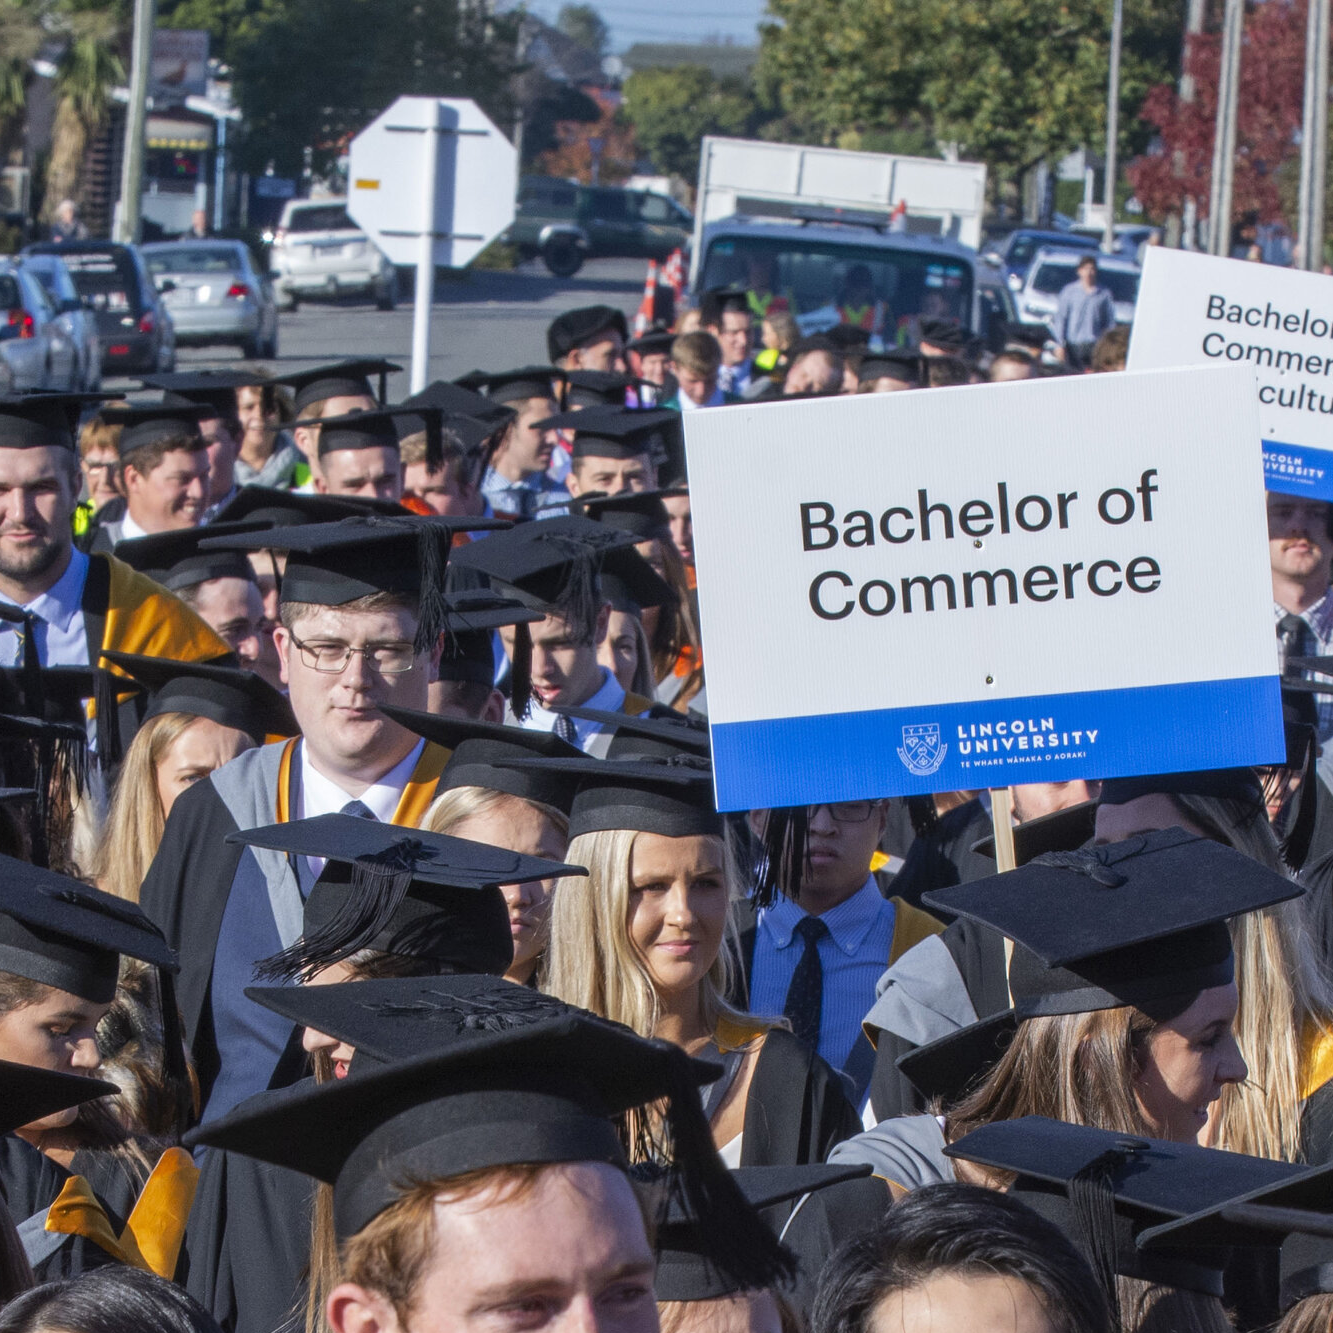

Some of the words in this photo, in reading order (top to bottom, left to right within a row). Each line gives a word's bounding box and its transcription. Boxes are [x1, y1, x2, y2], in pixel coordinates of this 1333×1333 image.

[1263, 452, 1302, 466] NCOLN
[1265, 462, 1324, 479] IVERSITY
[799, 482, 1078, 552] Bachelor
[1097, 468, 1159, 526] of
[808, 555, 1162, 621] Commerce
[957, 717, 1054, 739] LINCOLN
[959, 730, 1099, 755] UNIVERSITY
[973, 758, 1003, 767] WHARE
[1054, 751, 1086, 760] AORAKI
